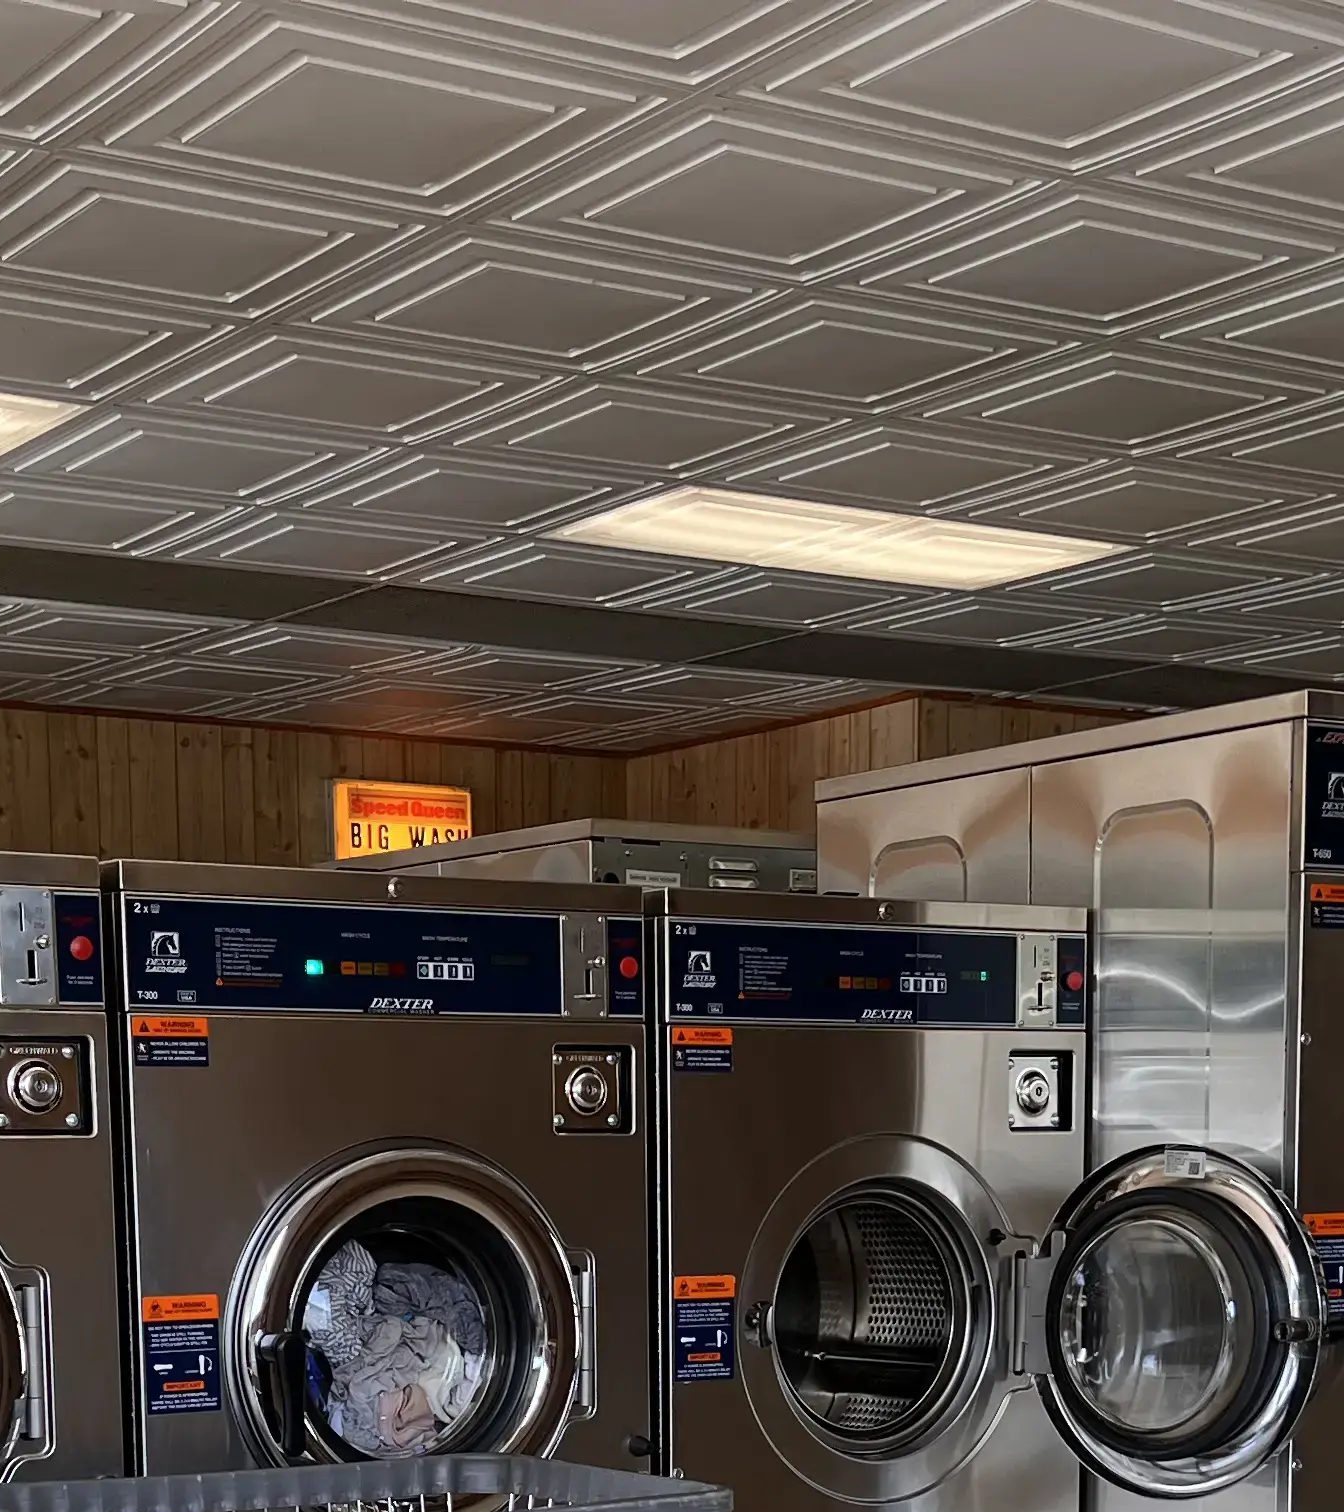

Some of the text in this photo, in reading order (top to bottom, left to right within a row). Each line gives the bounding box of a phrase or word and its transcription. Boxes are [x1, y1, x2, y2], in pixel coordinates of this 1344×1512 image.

[350, 798, 465, 820] Speed Queen
[351, 823, 389, 850] BIG
[134, 902, 141, 913] 2
[676, 925, 681, 935] 2
[145, 958, 186, 967] DEXTER
[137, 990, 158, 1000] T-300
[370, 997, 434, 1010] DEXTER
[861, 1008, 913, 1020] DEXTER
